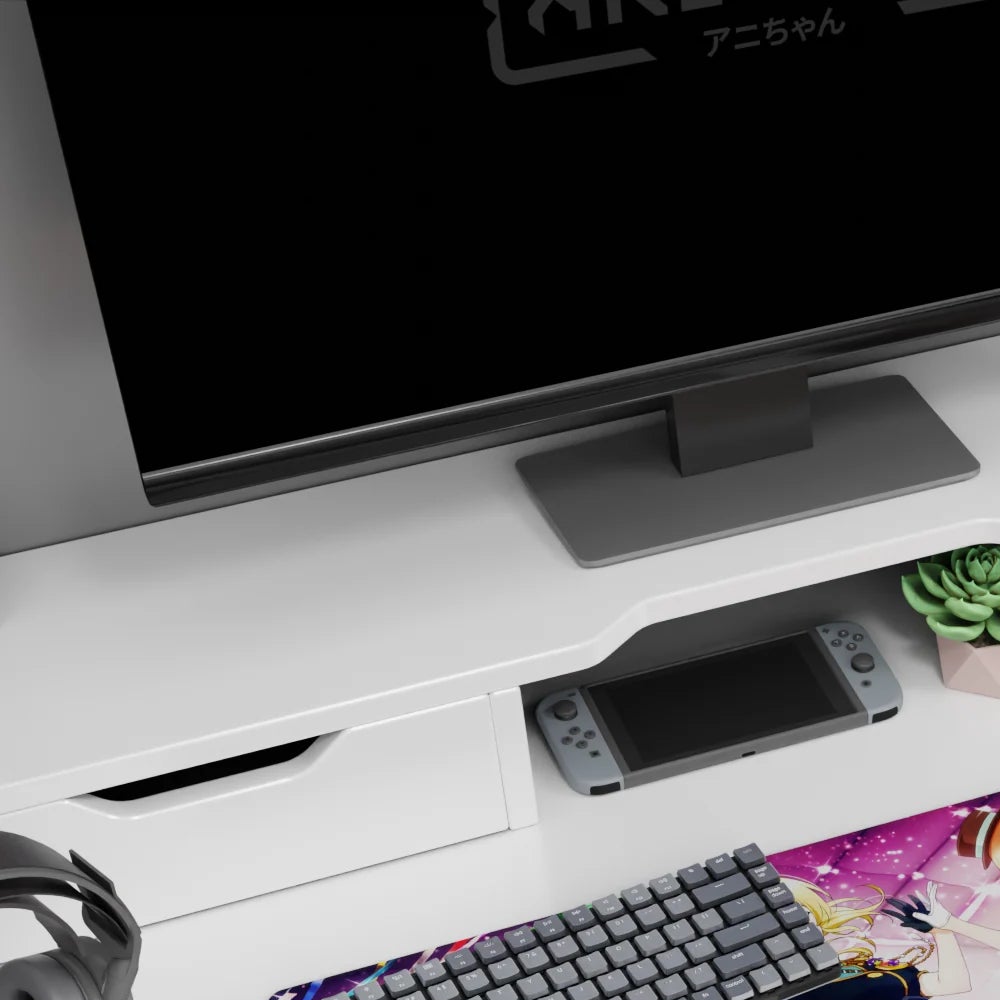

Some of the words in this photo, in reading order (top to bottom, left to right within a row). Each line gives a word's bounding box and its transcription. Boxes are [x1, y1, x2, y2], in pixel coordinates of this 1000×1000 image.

[703, 7, 846, 58] アニちゃん
[725, 978, 744, 989] control
